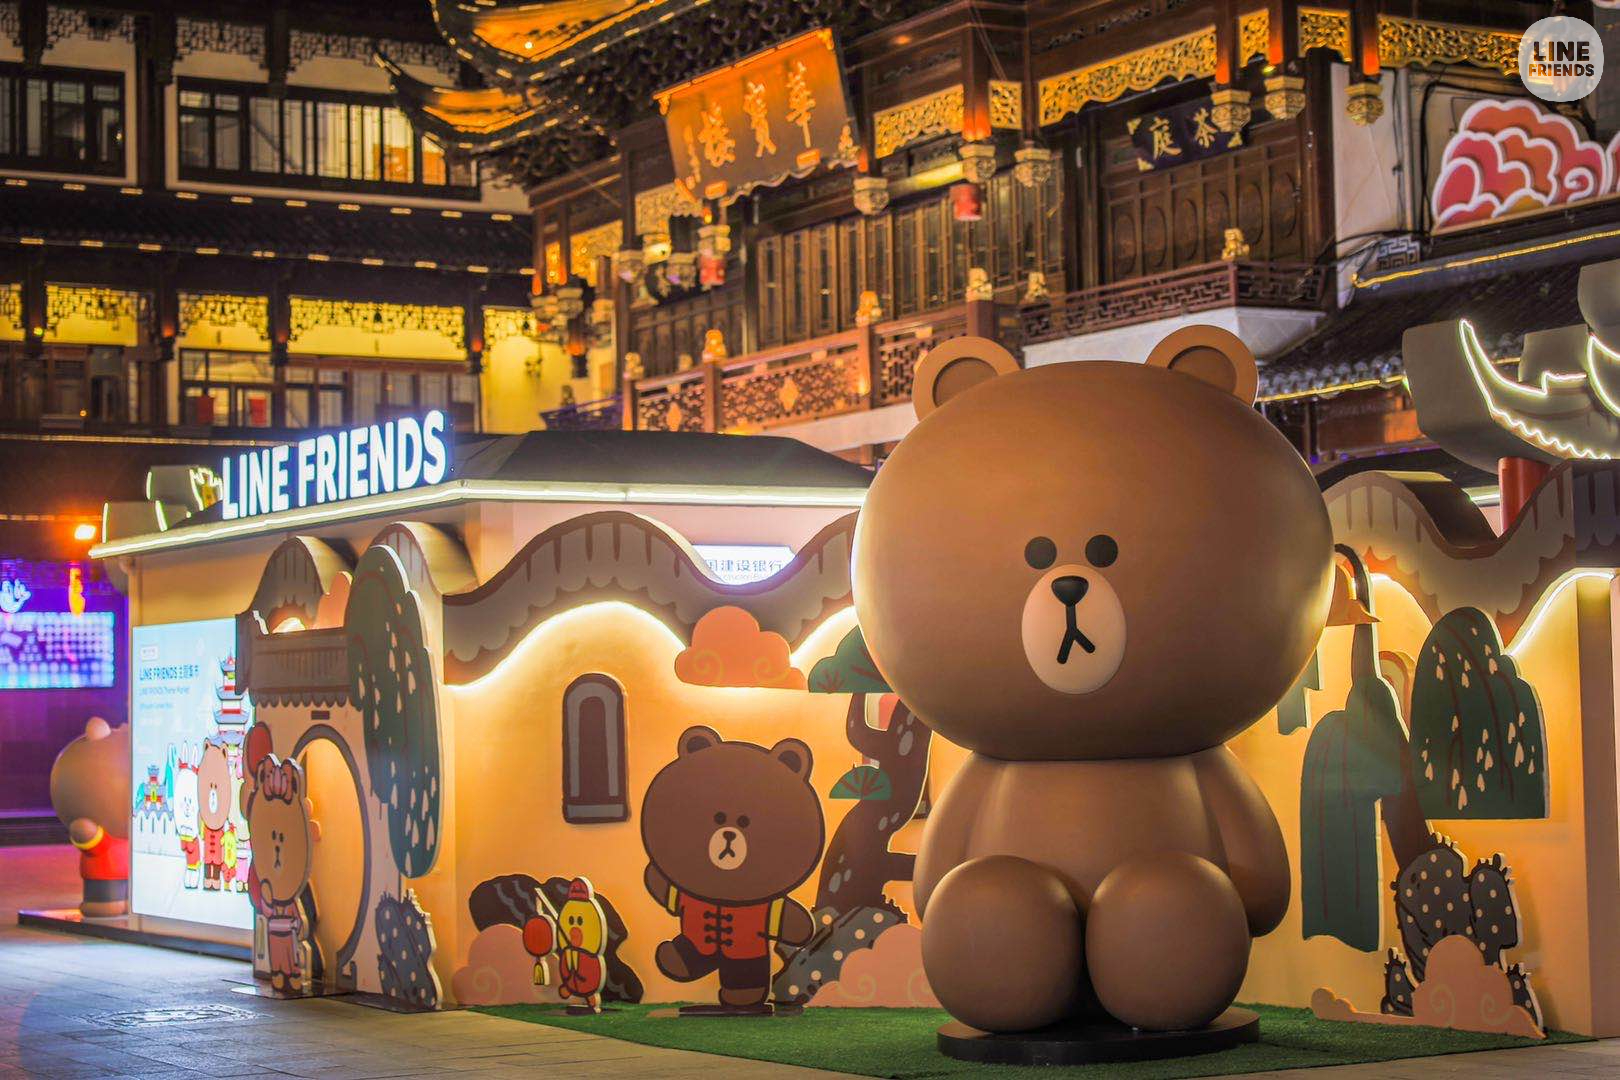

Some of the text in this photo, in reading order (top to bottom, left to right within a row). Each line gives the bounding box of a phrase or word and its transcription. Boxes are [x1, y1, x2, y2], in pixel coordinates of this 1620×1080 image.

[222, 410, 446, 520] LINE FRIENDS
[140, 667, 152, 681] LINE
[153, 666, 178, 680] FRIENDS
